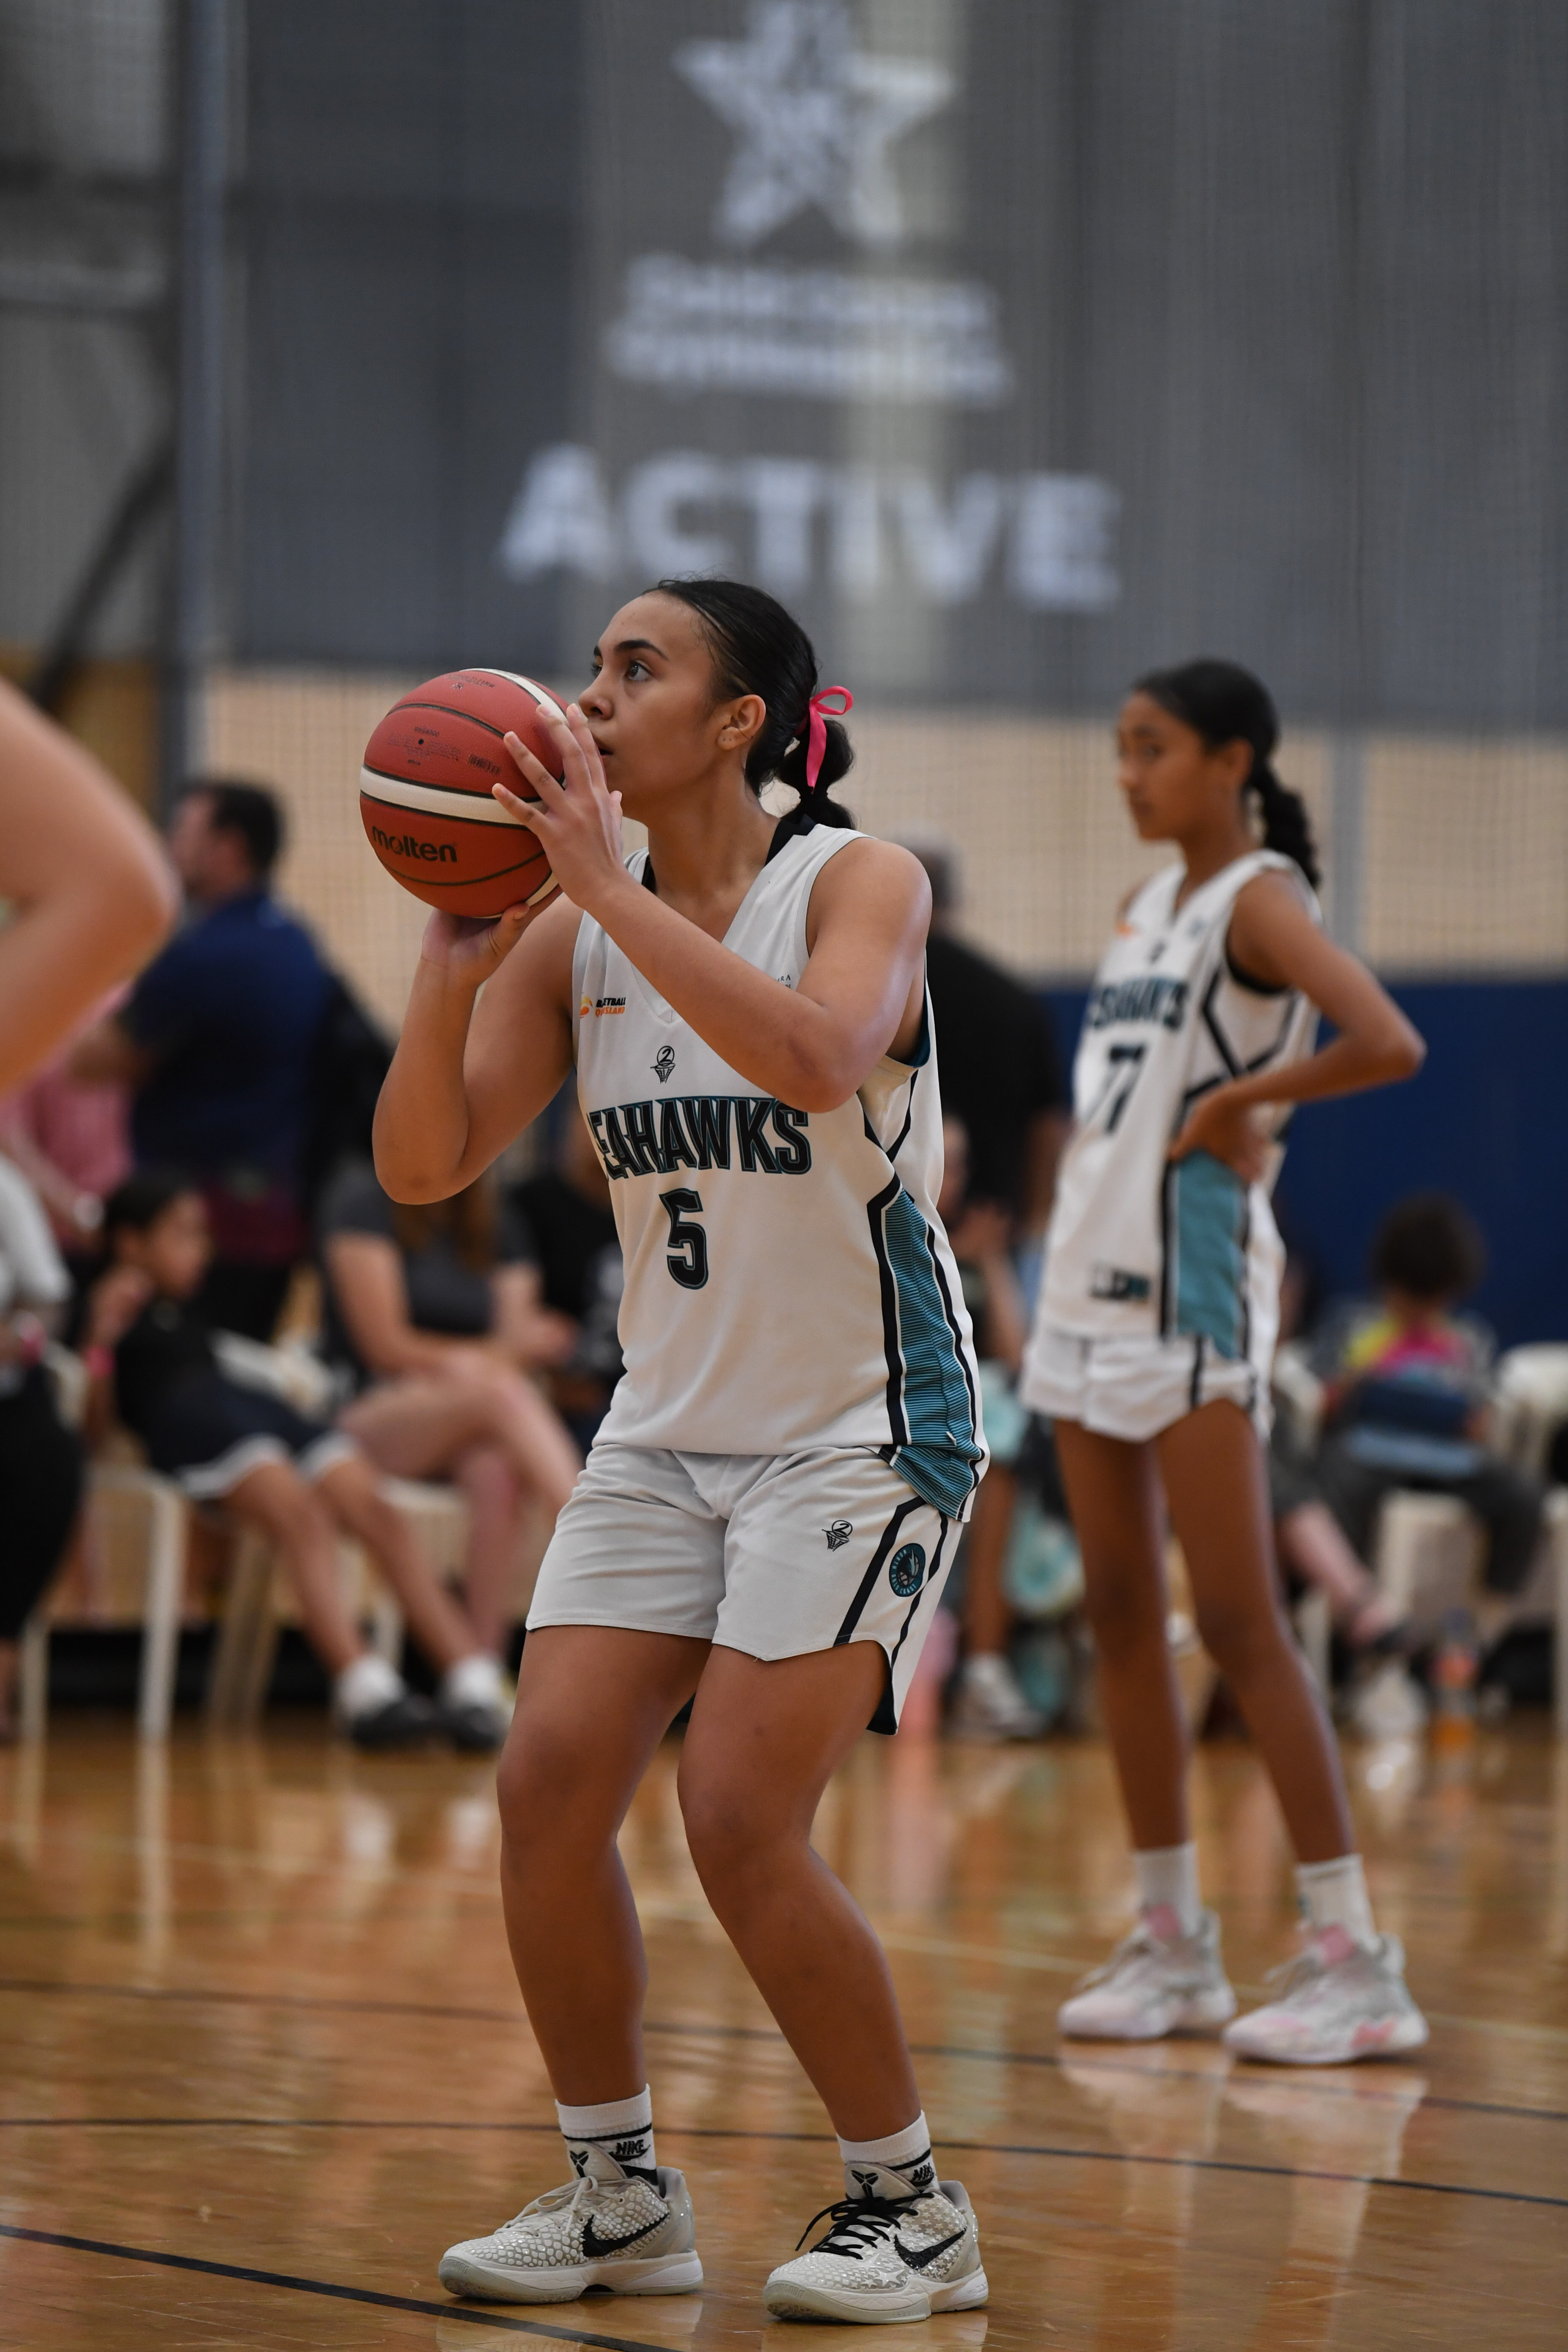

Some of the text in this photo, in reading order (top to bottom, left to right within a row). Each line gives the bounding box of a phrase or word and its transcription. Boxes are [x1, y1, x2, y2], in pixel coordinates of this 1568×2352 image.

[498, 441, 1122, 612] ACTIVE
[372, 826, 457, 862] molten
[586, 1096, 812, 1180] EAHAWKS
[659, 1188, 709, 1290] 5
[891, 1549, 917, 1594] NORTH GOLD COAST
[615, 2139, 644, 2155] NIKE
